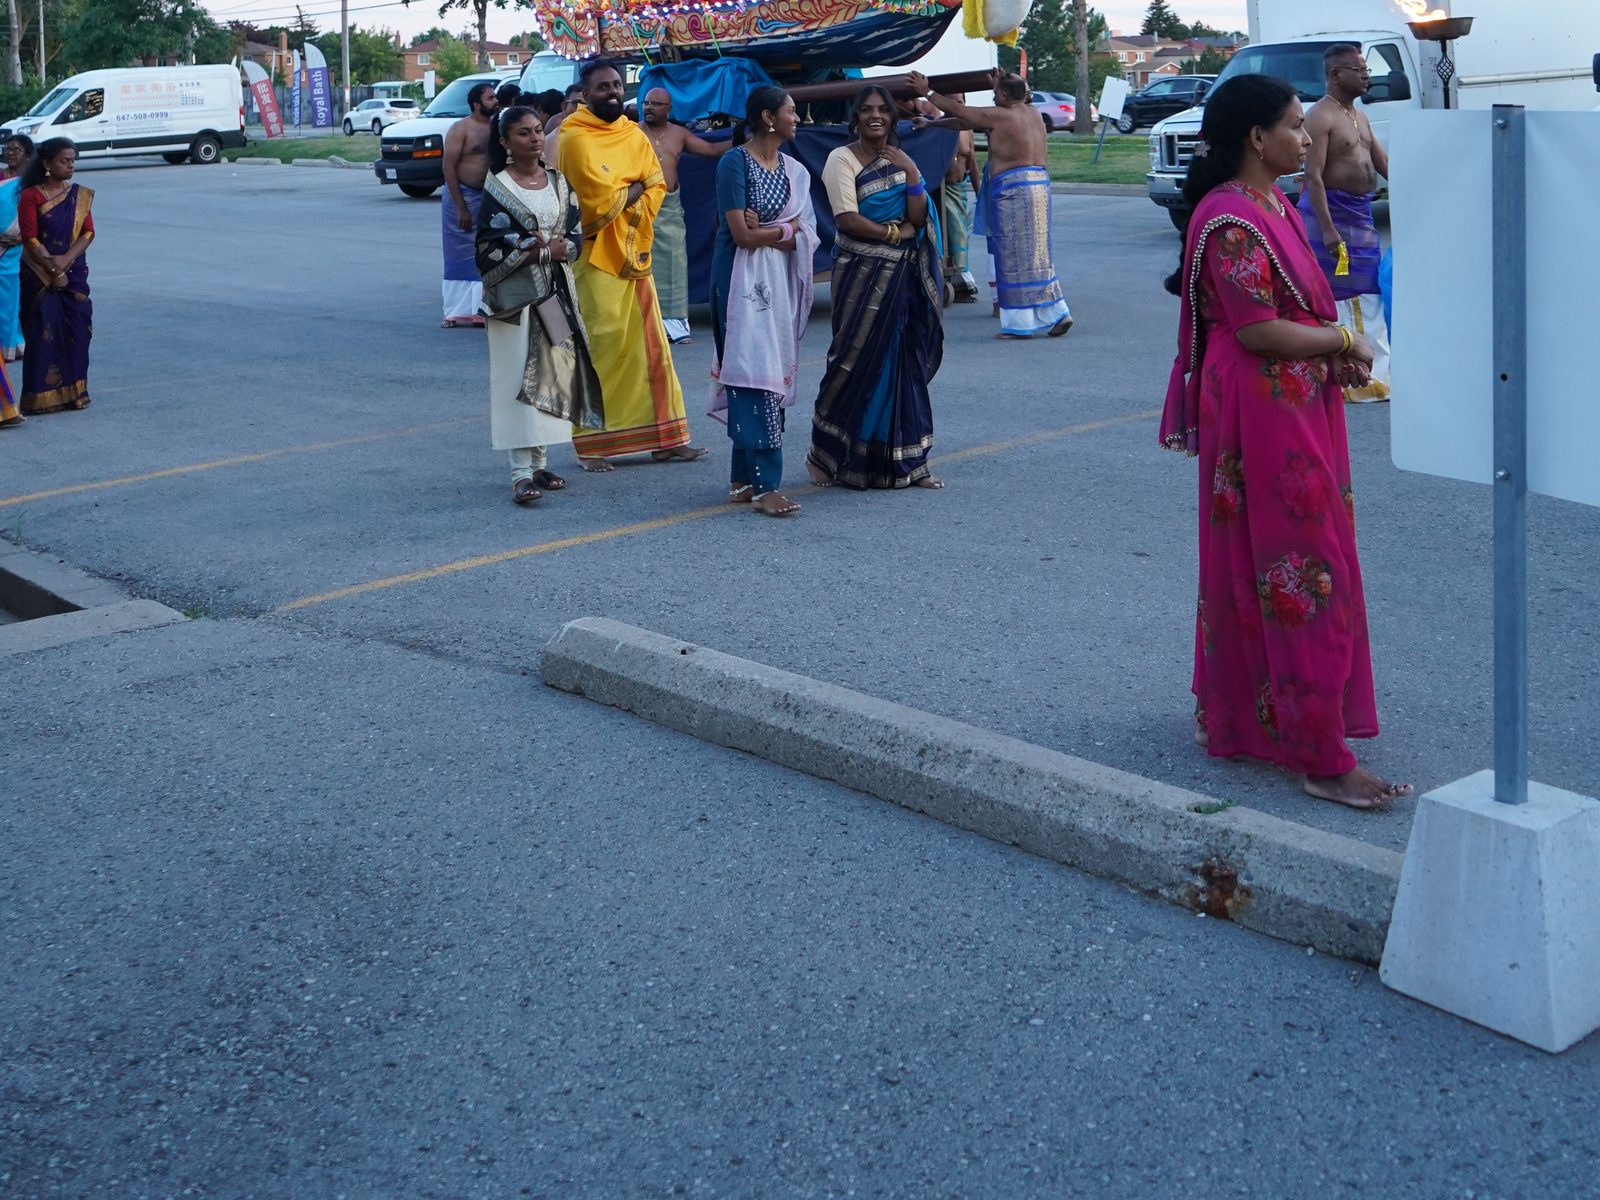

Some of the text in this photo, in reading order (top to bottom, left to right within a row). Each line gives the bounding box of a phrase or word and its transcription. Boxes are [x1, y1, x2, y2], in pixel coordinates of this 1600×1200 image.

[311, 71, 328, 126] Royal Bath
[116, 111, 169, 122] 647-508-0999
